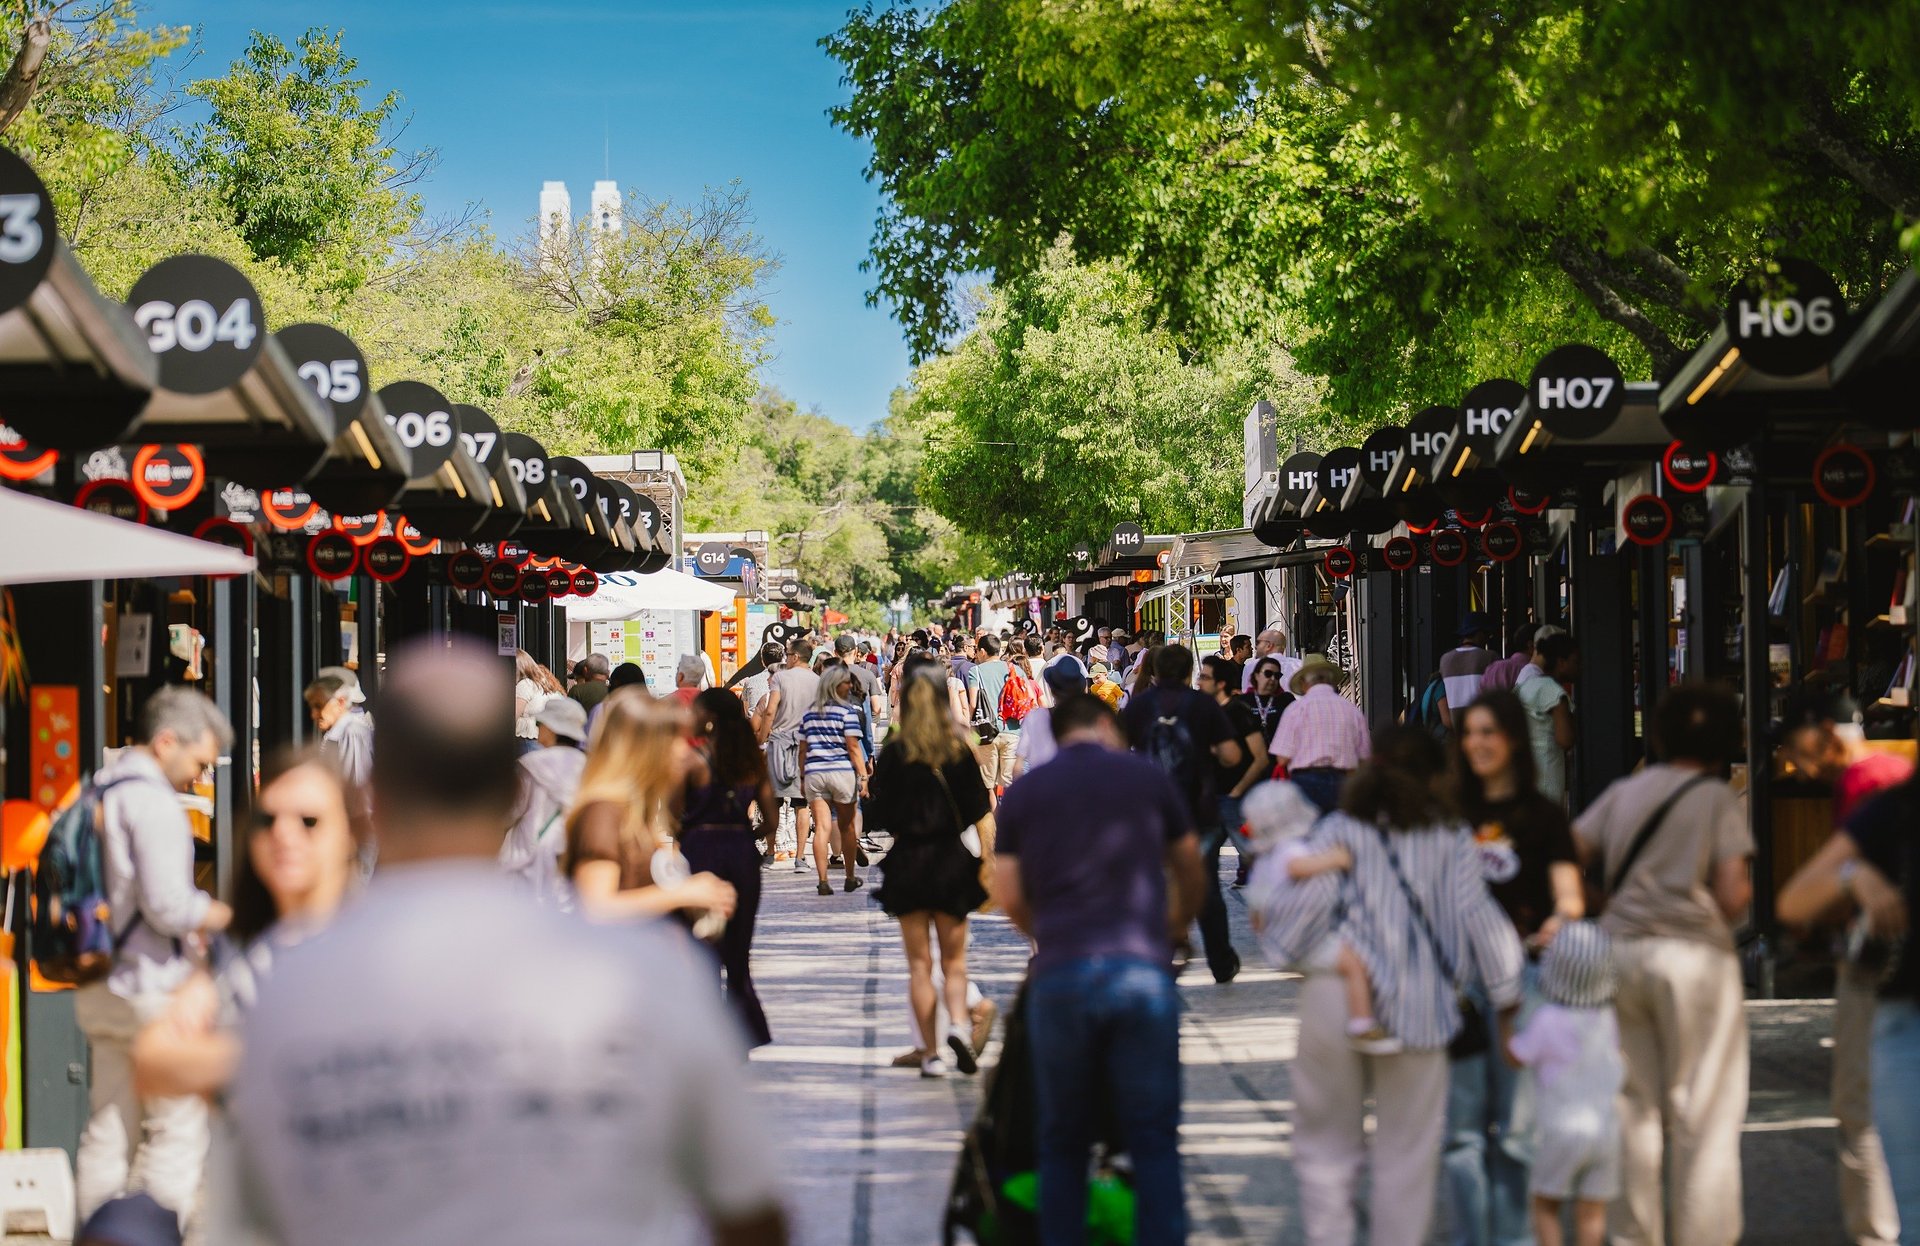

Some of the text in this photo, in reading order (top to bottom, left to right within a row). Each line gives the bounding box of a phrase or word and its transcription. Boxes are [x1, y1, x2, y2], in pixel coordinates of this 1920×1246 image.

[134, 298, 257, 353] G04
[1739, 297, 1836, 338] H06
[1538, 377, 1614, 409] H07
[384, 411, 451, 448] 06
[1466, 407, 1521, 436] H0
[1288, 471, 1318, 490] H1
[1115, 533, 1140, 545] H14
[504, 547, 518, 556] MB
[701, 552, 726, 564] G14
[781, 584, 798, 593] G19
